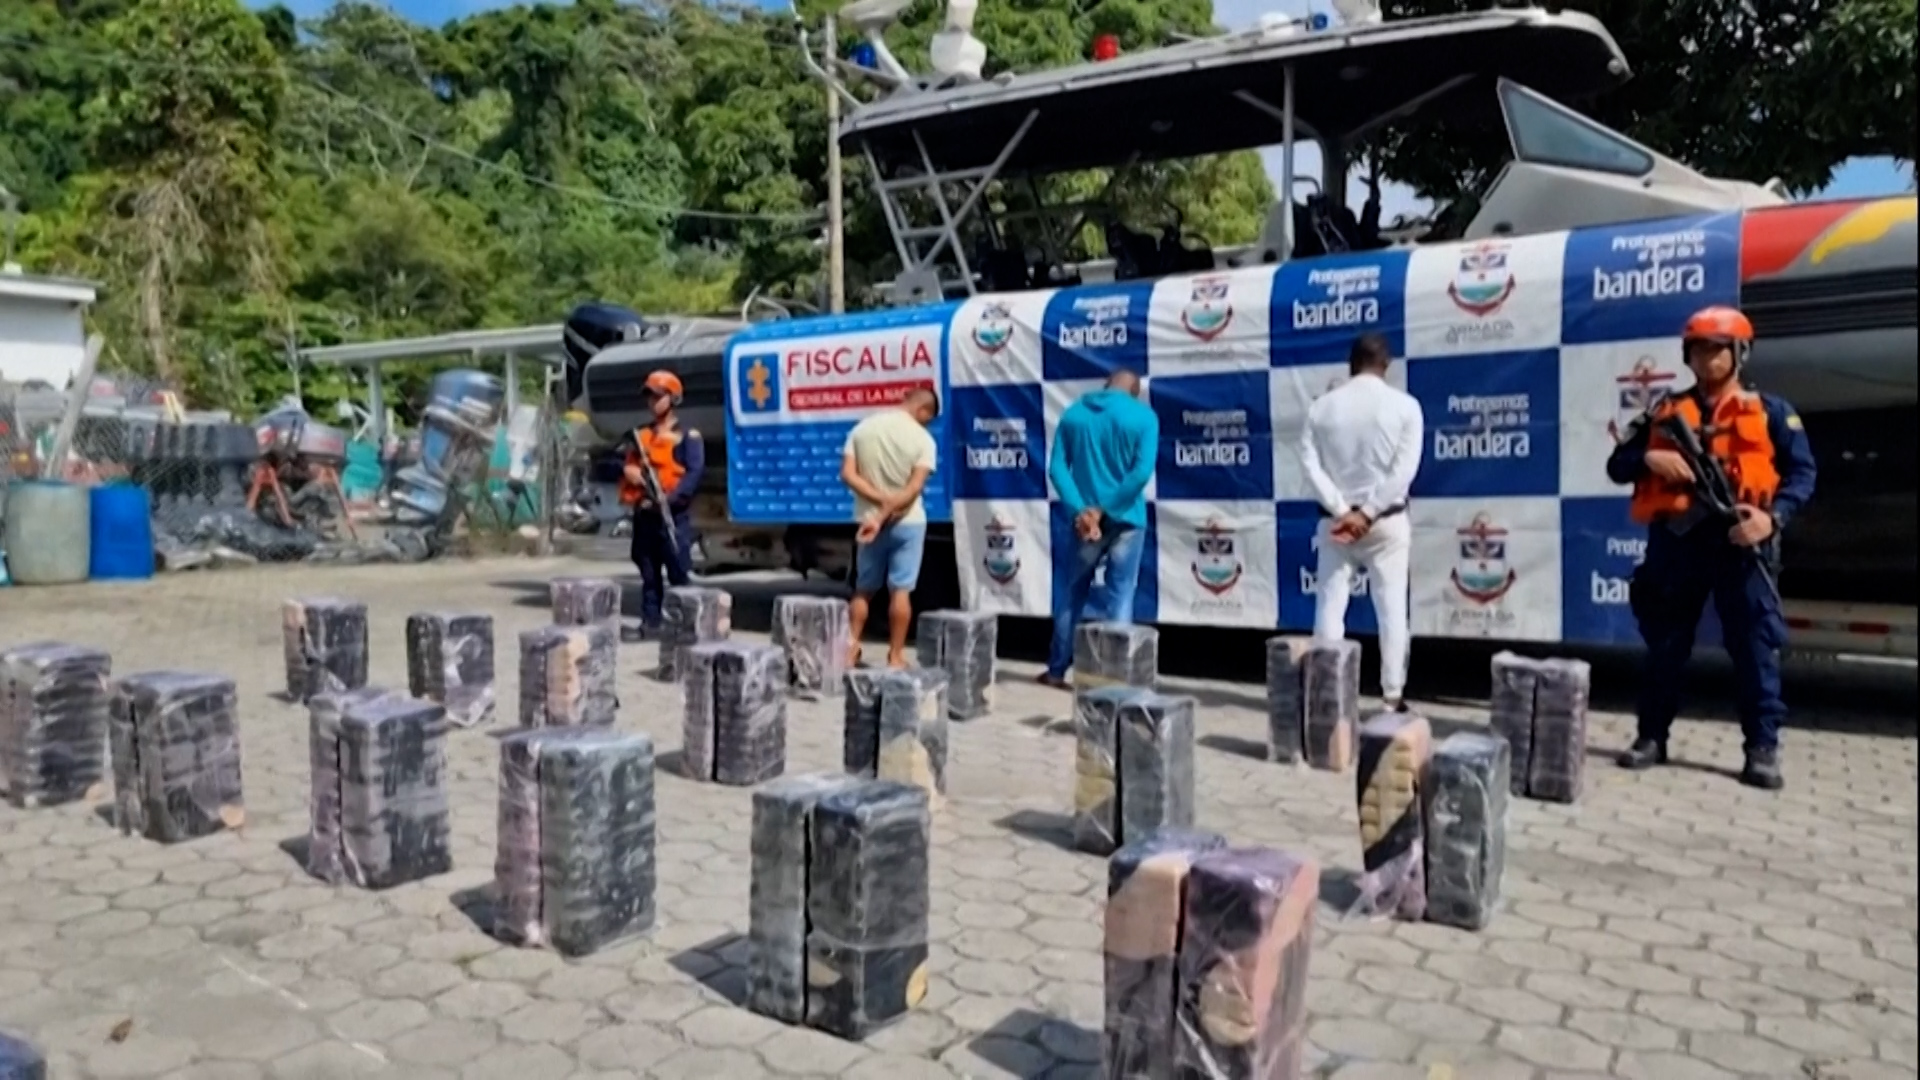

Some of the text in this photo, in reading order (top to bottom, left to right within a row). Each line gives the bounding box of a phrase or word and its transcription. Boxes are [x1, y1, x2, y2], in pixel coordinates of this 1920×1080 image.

[1593, 262, 1704, 300] bandera
[1293, 296, 1379, 329] bandera
[787, 336, 932, 377] FISCALÍA
[866, 387, 882, 403] LA
[1175, 438, 1250, 467] bandera
[1434, 428, 1530, 460] bandera
